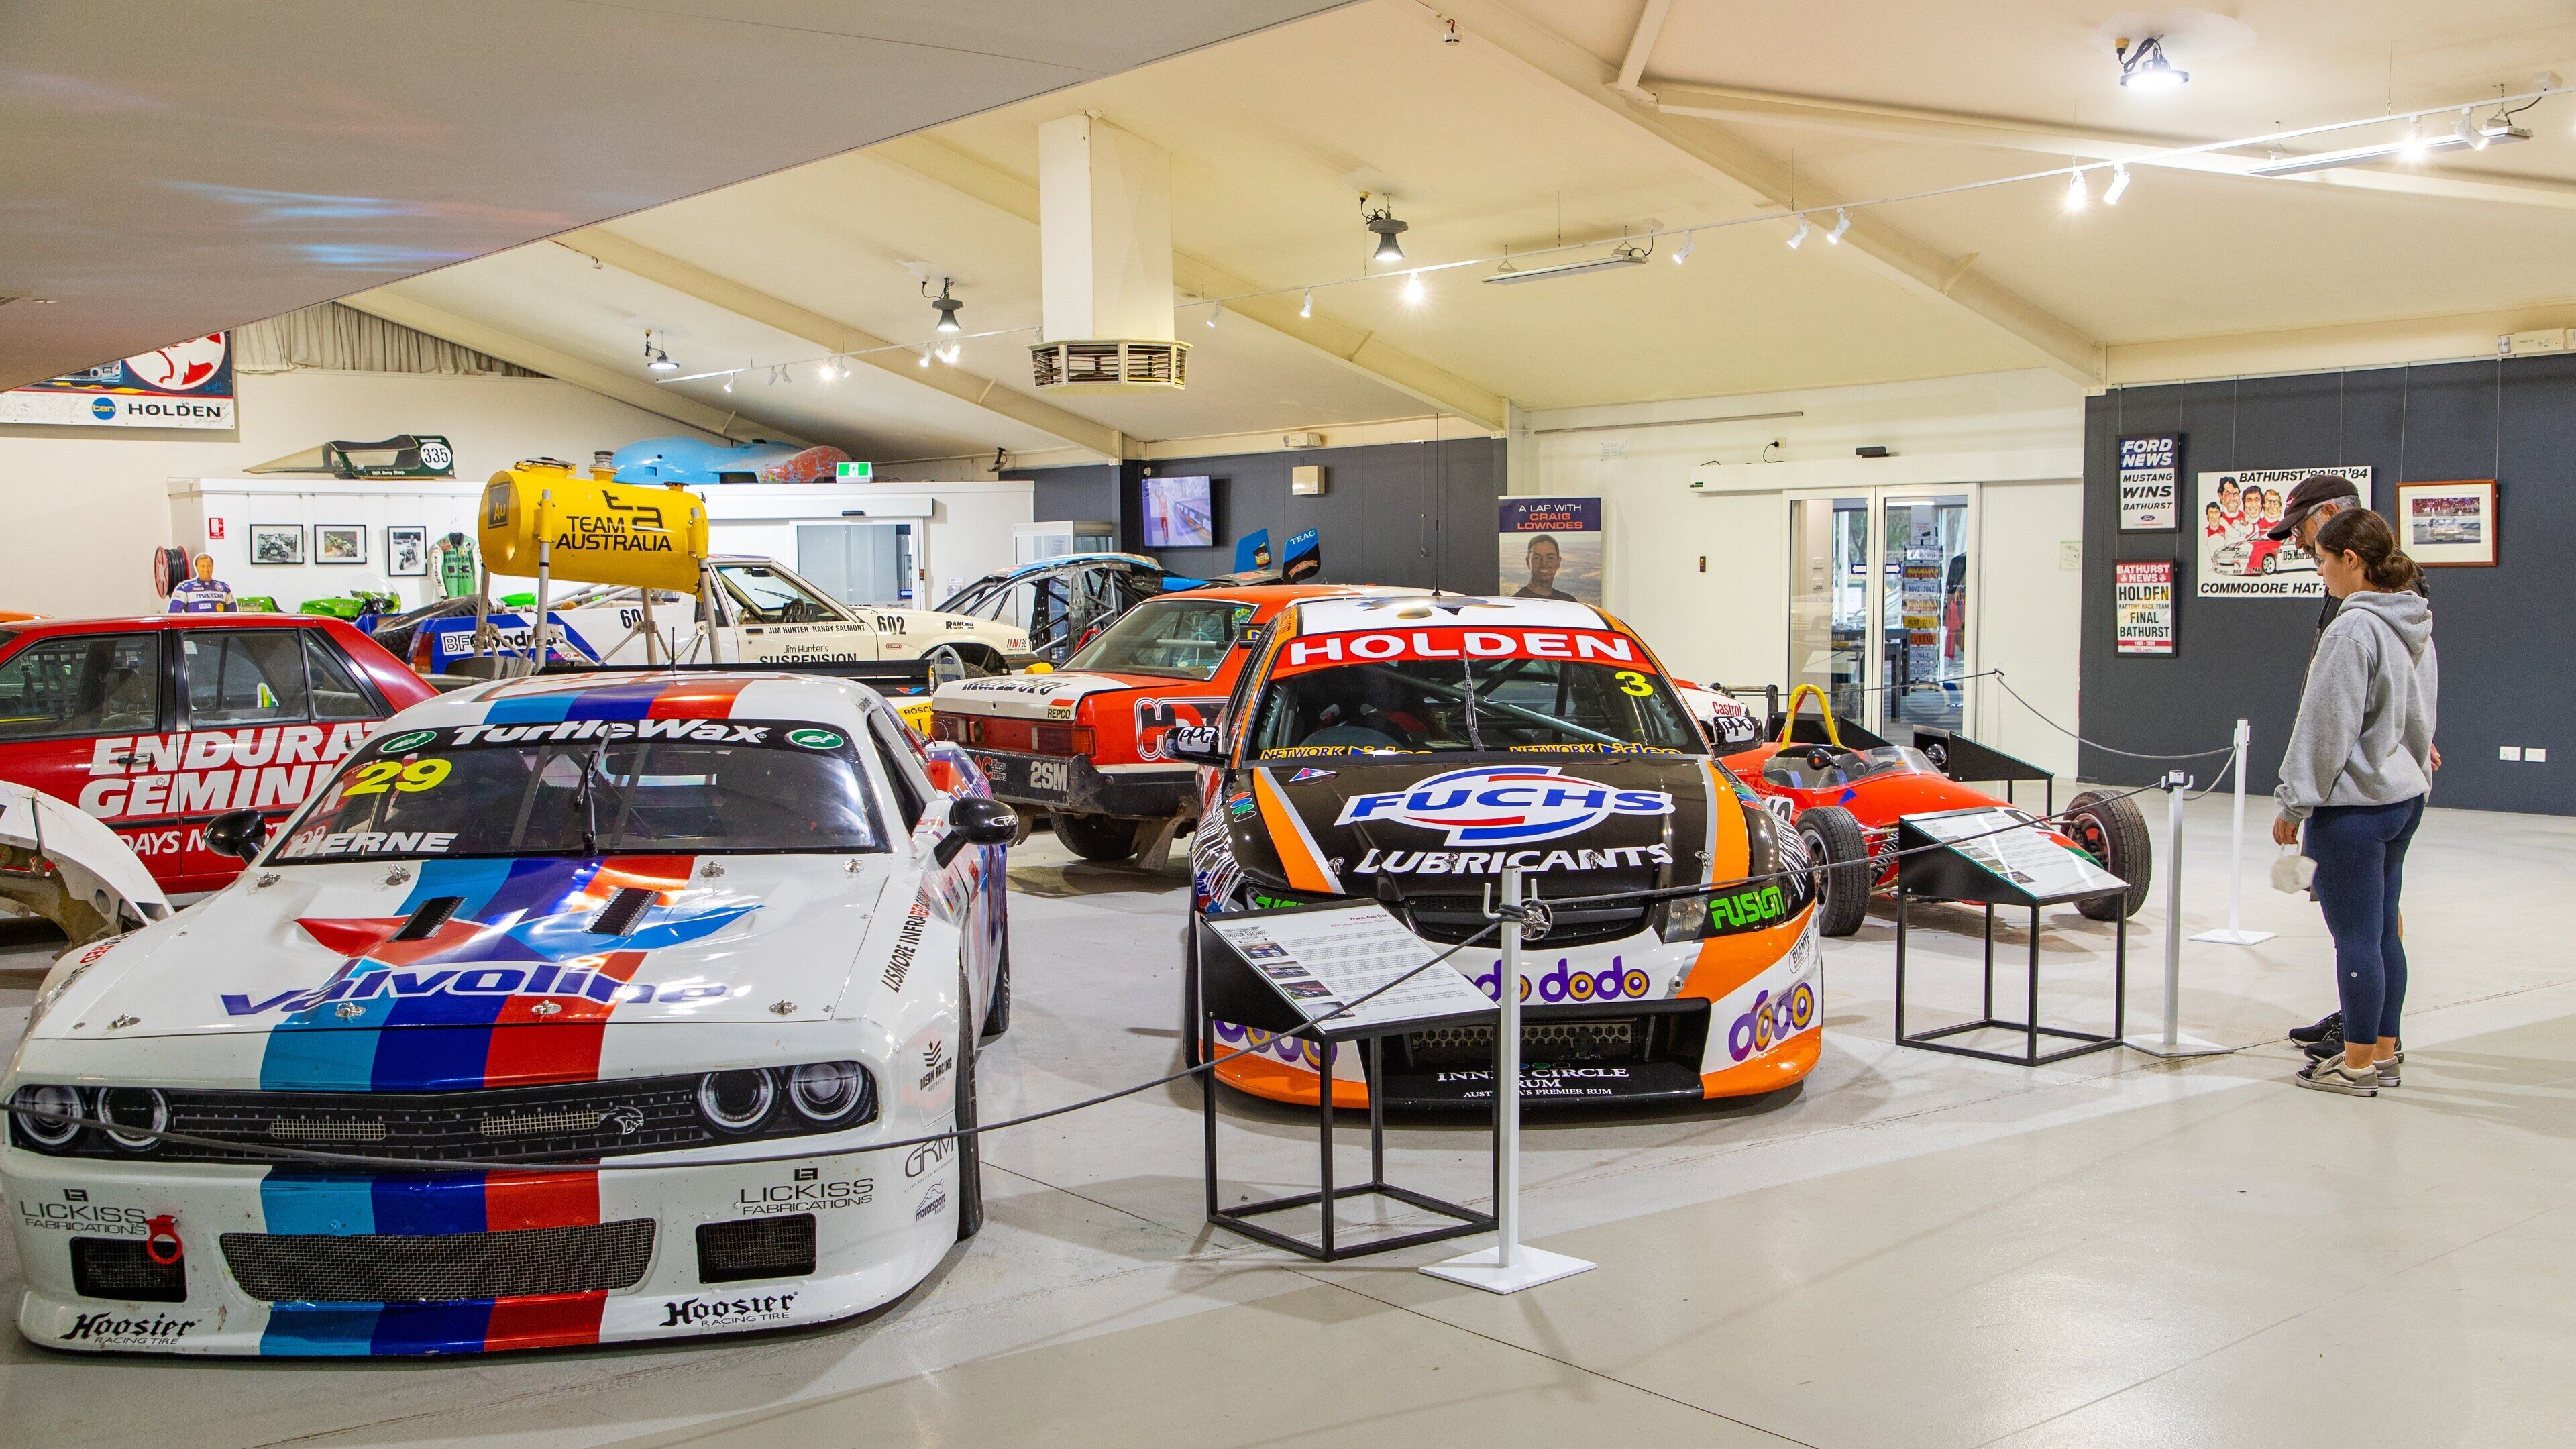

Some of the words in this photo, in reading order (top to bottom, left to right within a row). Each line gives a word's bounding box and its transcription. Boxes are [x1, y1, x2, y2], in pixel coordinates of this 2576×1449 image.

[92, 405, 115, 413] ten
[128, 403, 221, 417] HOLDEN
[2122, 439, 2173, 453] FORD
[423, 448, 448, 463] 335
[2122, 452, 2173, 468] NEWS
[2123, 473, 2173, 482] MUSTANG
[2239, 471, 2306, 482] BATHURST
[2349, 468, 2368, 479] '84
[2123, 486, 2173, 498] WINS
[493, 502, 506, 521] Au
[2123, 502, 2173, 511] BATHURST
[566, 515, 625, 533] TEAM
[1517, 521, 1583, 530] LOWNDES
[1529, 513, 1570, 521] CRAIG
[555, 533, 672, 551] AUSTRALIA
[1289, 530, 1316, 545] TEAC
[2116, 564, 2170, 574] BATHURST
[2129, 574, 2158, 582] NEWS
[2119, 586, 2169, 601] HOLDEN
[2200, 583, 2288, 594] COMMODORE
[620, 608, 645, 629] 60
[877, 616, 906, 635] 602
[2130, 612, 2159, 623] FINAL
[783, 626, 809, 634] HUNTER
[2120, 627, 2169, 637] BATHURST
[783, 645, 796, 653] Jim
[798, 644, 829, 653] Hunter's
[1291, 632, 1634, 665] HOLDEN
[759, 653, 857, 663] SUSPENSION
[1615, 671, 1654, 696] 3
[1047, 708, 1071, 719] REPCO
[1712, 701, 1741, 716] Castrol
[452, 720, 771, 745] TurtleWax
[992, 759, 1006, 771] Plugs
[341, 759, 453, 797] 29
[1030, 761, 1068, 791] 2SM
[1350, 788, 1664, 817] FUCHS
[121, 830, 182, 855] DAYS
[284, 832, 458, 857] HERNE
[1353, 843, 1674, 874] LUBRICANTS
[1710, 885, 1785, 929] FUSION
[881, 944, 916, 994] LISMORE
[1539, 956, 1650, 1003] dodo
[221, 964, 728, 1016] Valvoline
[1729, 982, 1815, 1062] dodo
[920, 1071, 936, 1091] DREAM
[935, 1057, 952, 1077] RACING
[1531, 1069, 1629, 1077] CIRCLE
[905, 1125, 953, 1178] GRM
[741, 1178, 873, 1204] LICKISS
[19, 1201, 148, 1225] LICKISS
[742, 1195, 873, 1215] FABRICATIONS
[915, 1193, 947, 1223] motorsport
[25, 1218, 148, 1236] FABRICATIONS
[659, 1293, 796, 1327] Hoosier
[700, 1315, 757, 1327] RACING
[760, 1311, 789, 1323] TIRE
[59, 1311, 199, 1340] Hoosier
[94, 1336, 148, 1346] RACING
[150, 1336, 180, 1346] TIRE
